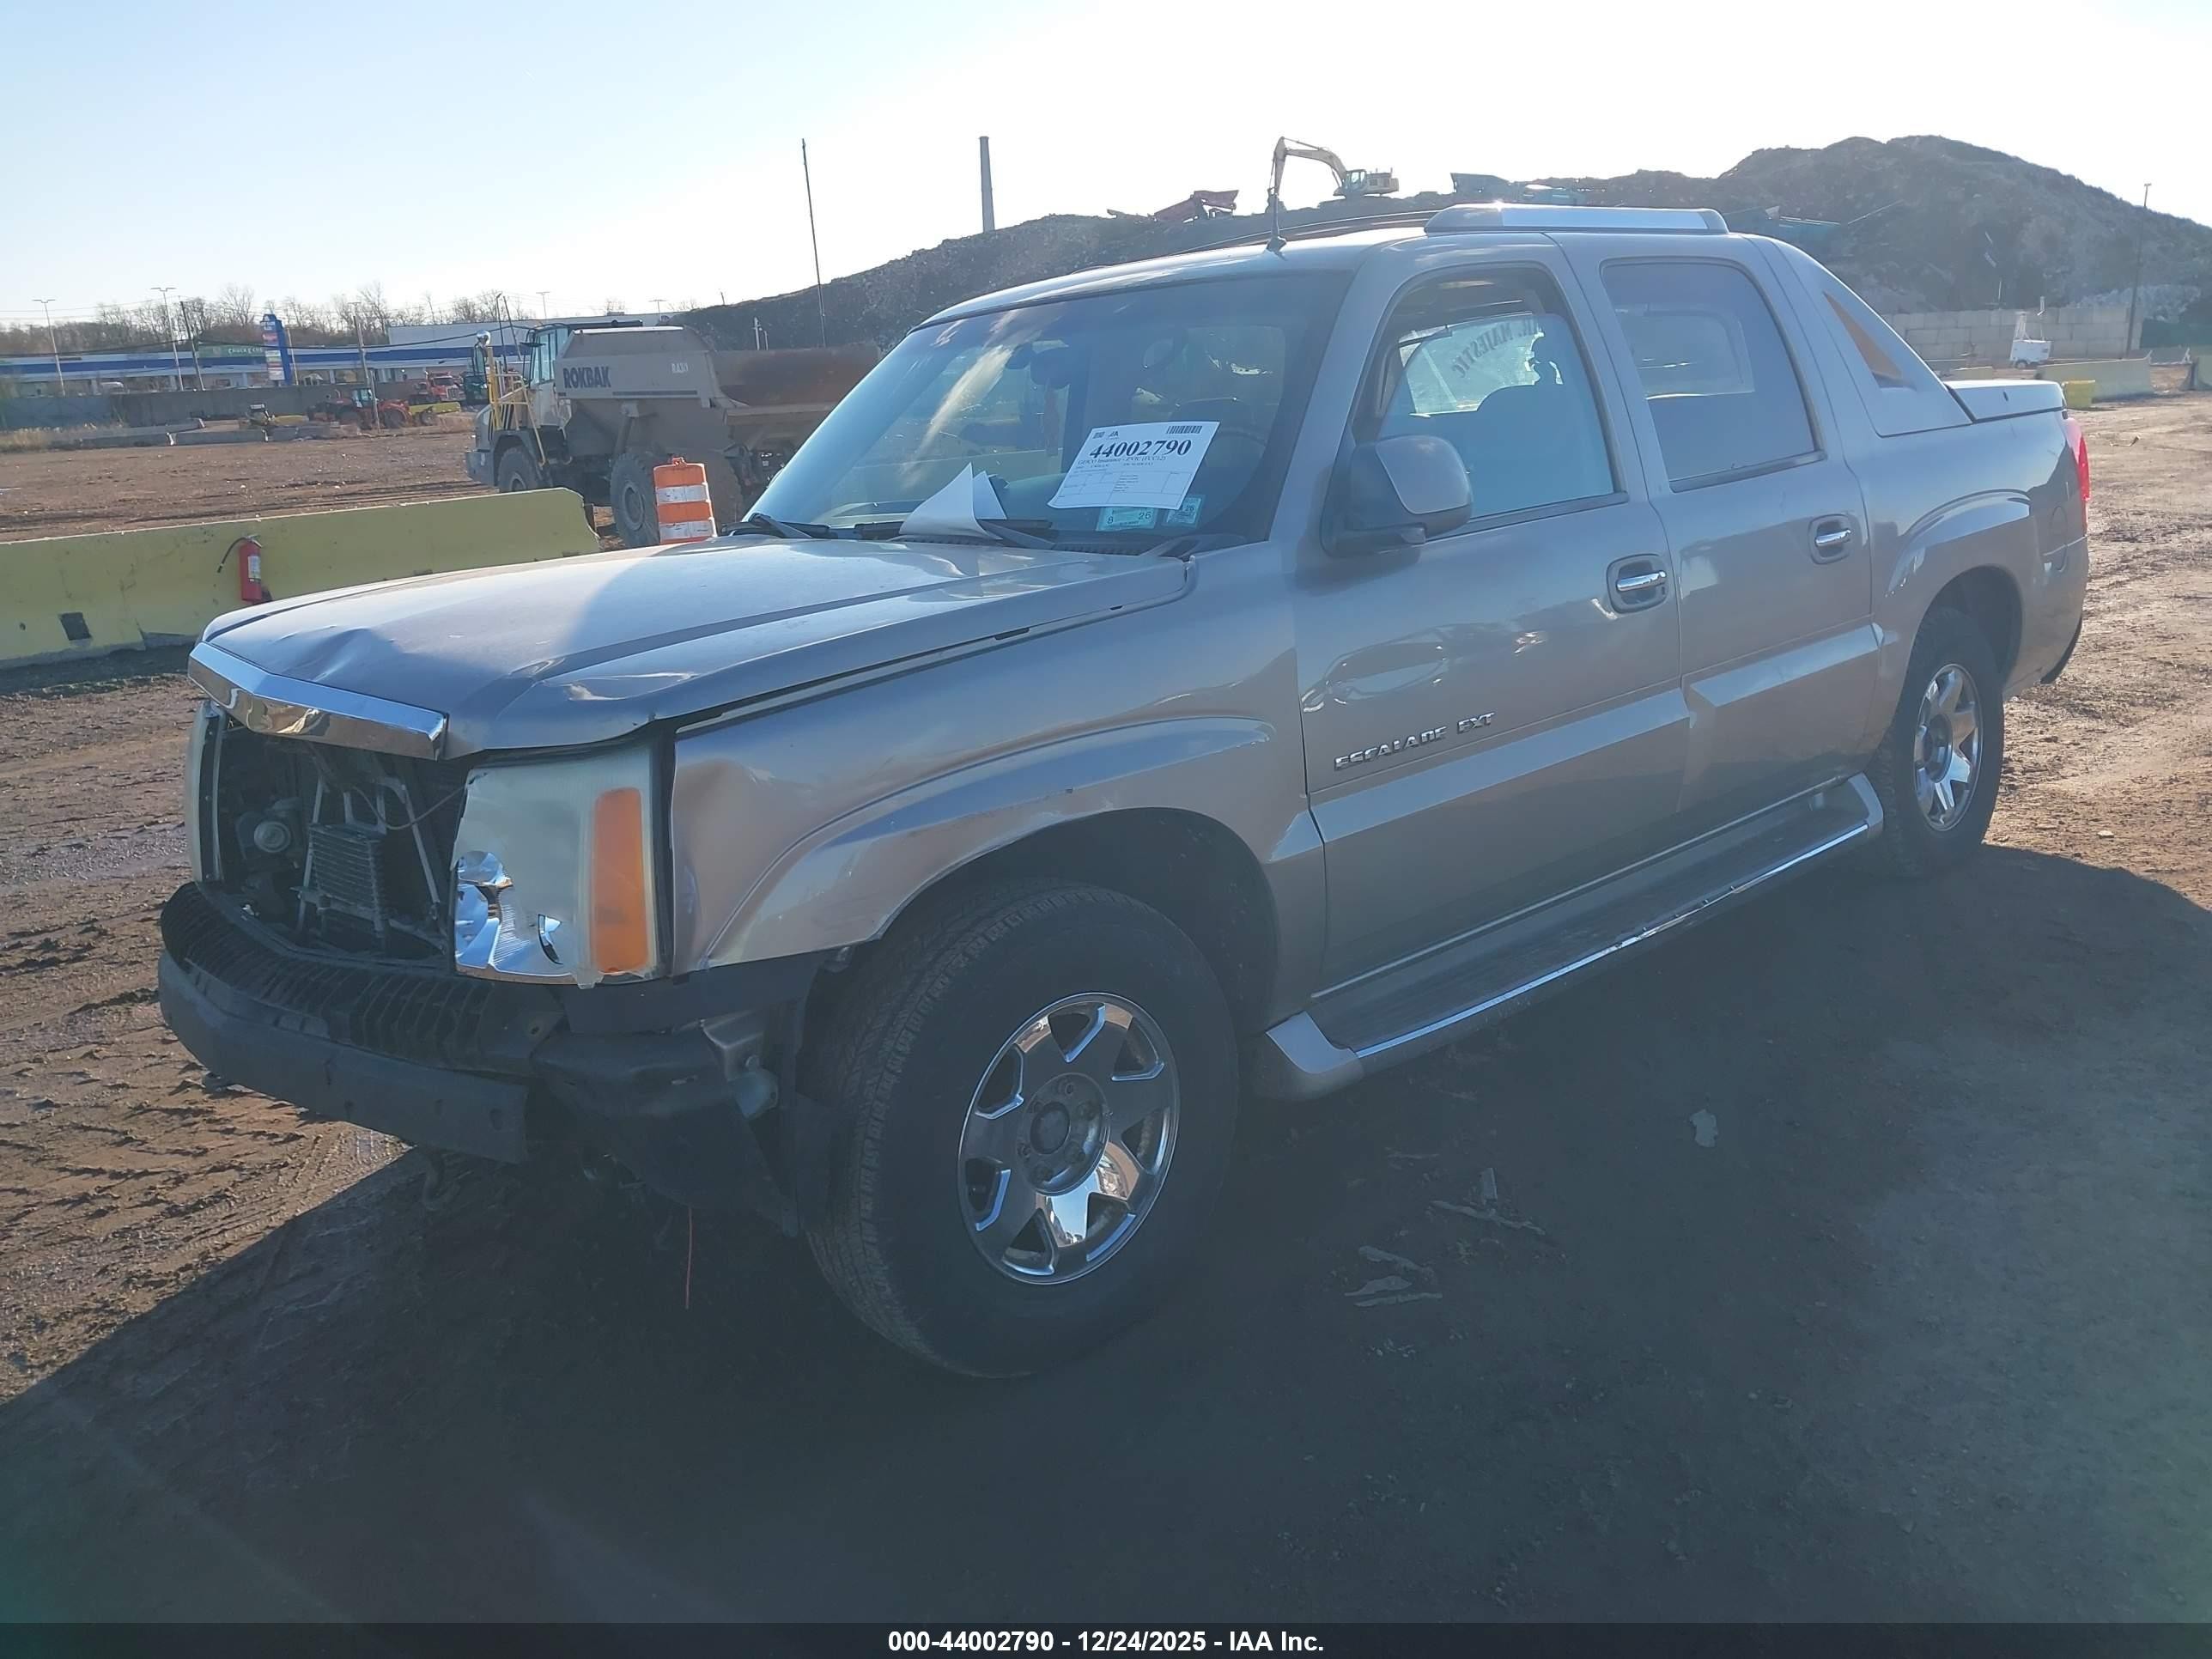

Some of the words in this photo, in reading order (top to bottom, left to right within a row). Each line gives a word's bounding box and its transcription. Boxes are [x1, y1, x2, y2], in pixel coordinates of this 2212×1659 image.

[563, 367, 611, 388] ROKBAK
[1090, 439, 1192, 459] 44002790
[1138, 511, 1152, 520] 26
[1334, 726, 1447, 769] ESCALADE
[1456, 712, 1495, 733] EXT
